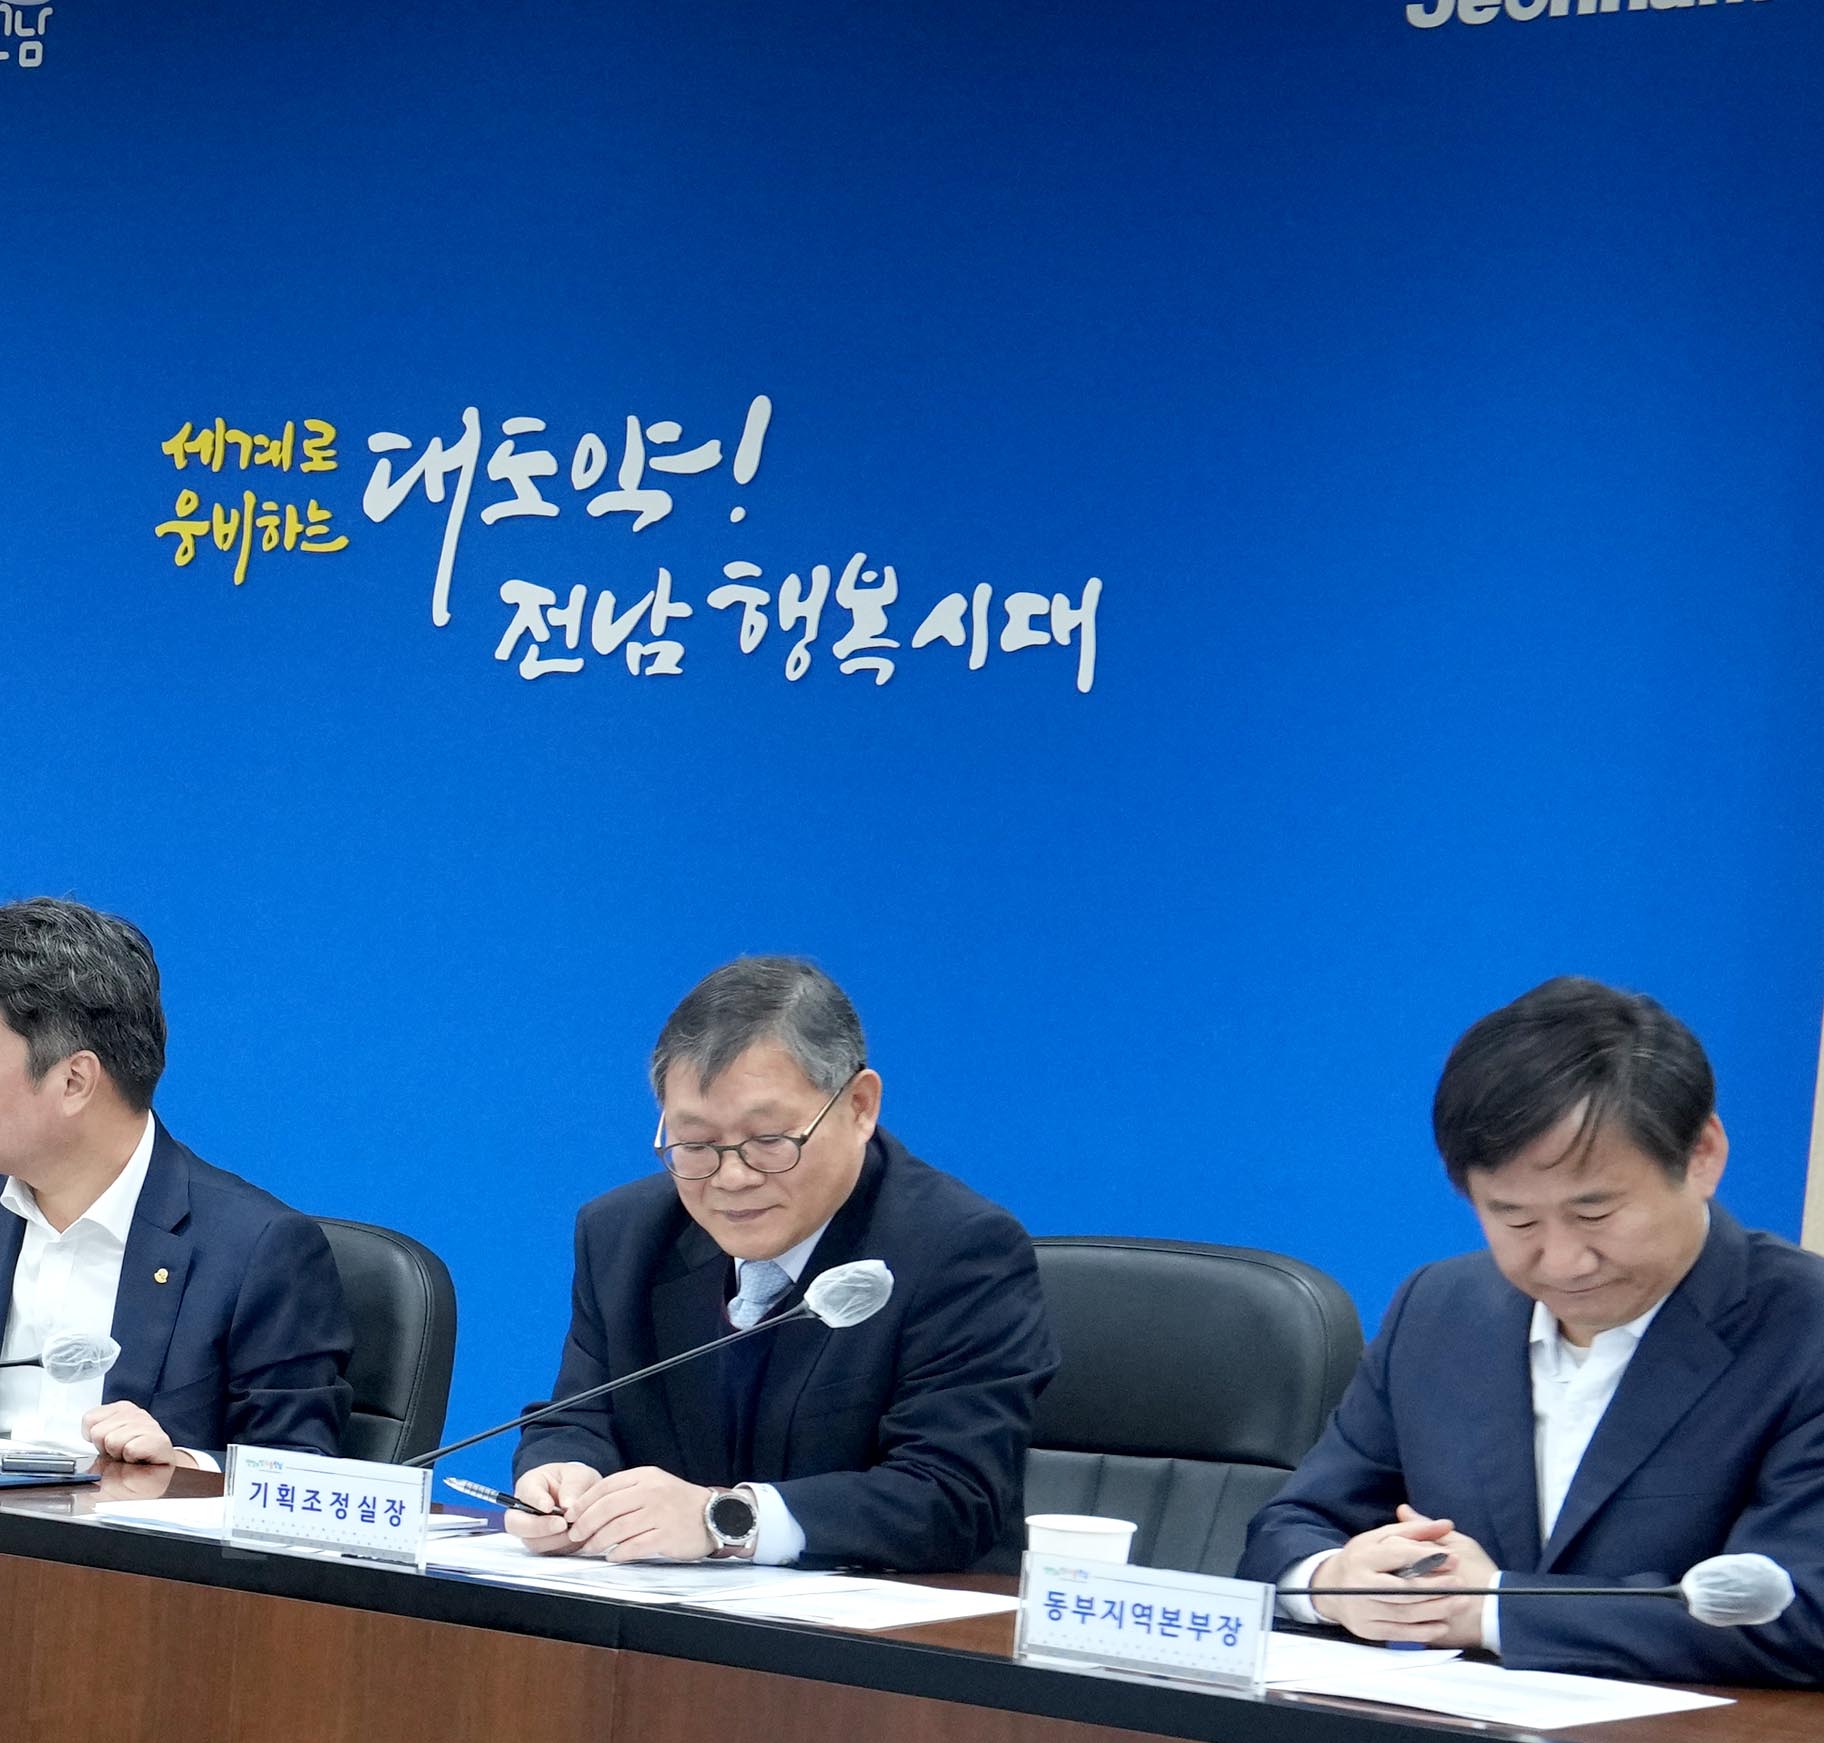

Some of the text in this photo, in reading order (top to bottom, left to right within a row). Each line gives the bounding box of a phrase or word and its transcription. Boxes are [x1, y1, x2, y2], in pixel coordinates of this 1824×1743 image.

[160, 417, 338, 474] 세계로
[154, 490, 350, 586] 웅비하는
[362, 395, 772, 627] 대도약!
[494, 567, 694, 680] 전남
[249, 1481, 406, 1527] 기획조정실장
[1043, 1590, 1243, 1647] 동부지역본부장
